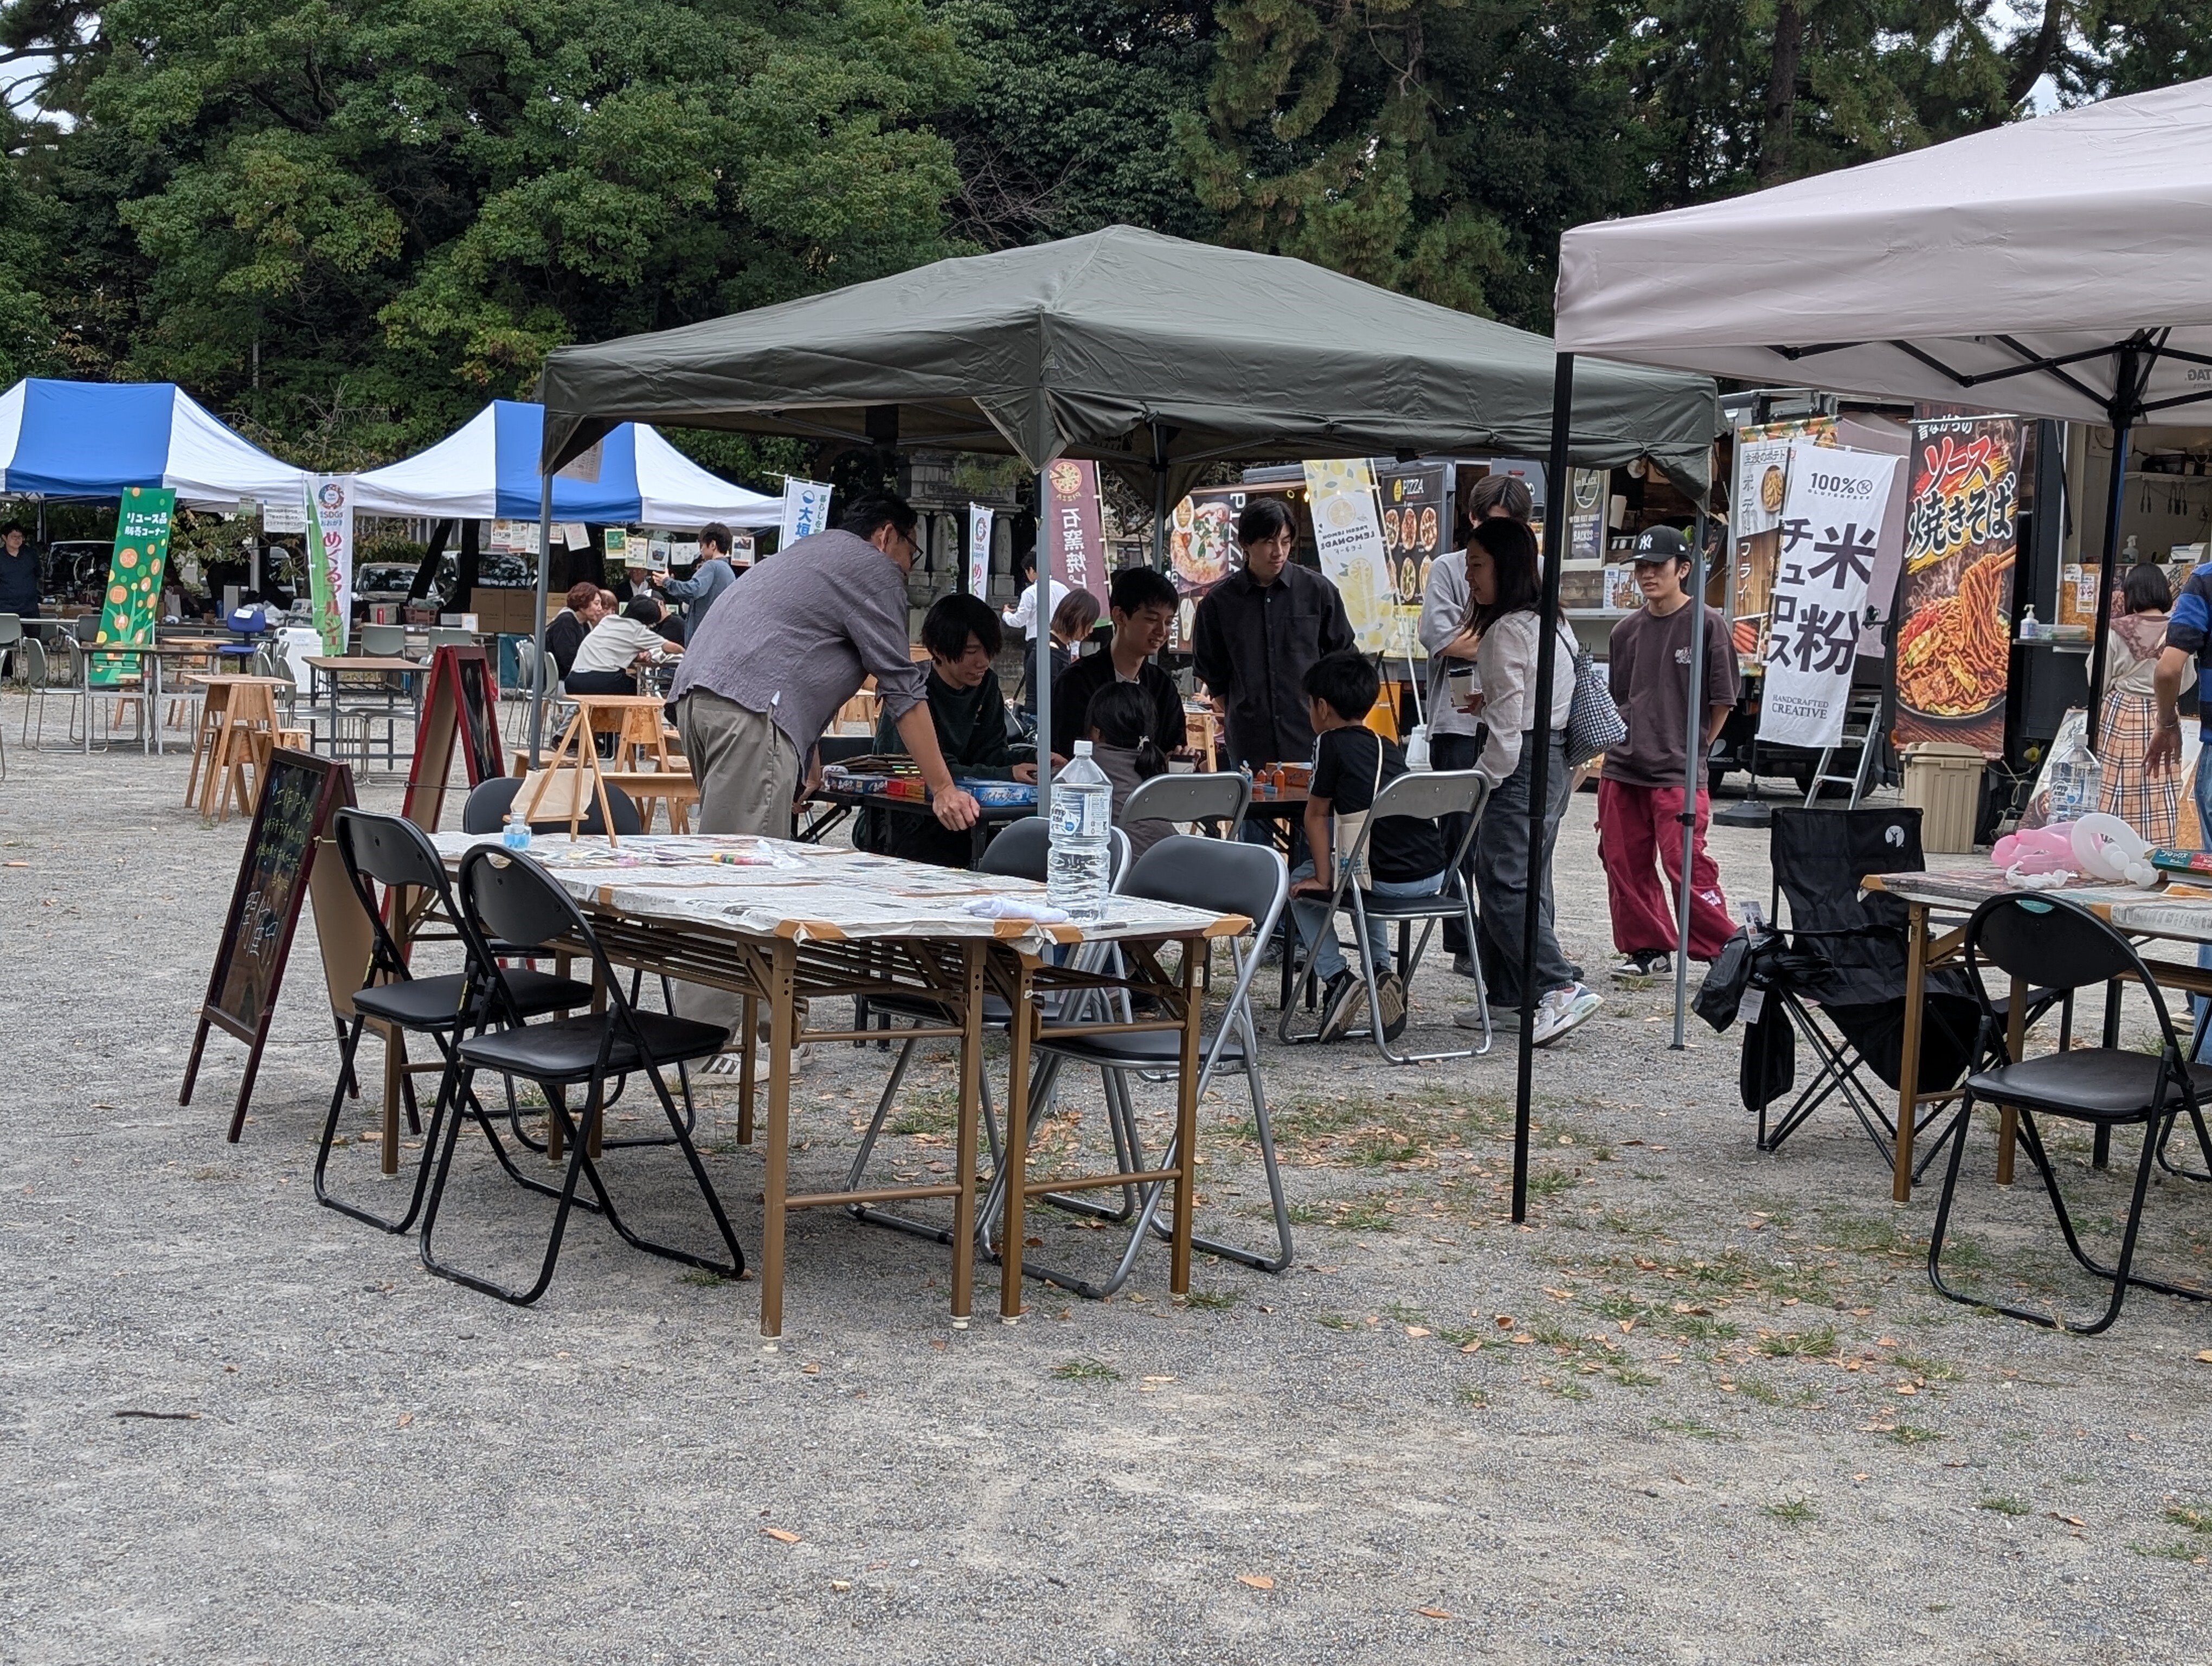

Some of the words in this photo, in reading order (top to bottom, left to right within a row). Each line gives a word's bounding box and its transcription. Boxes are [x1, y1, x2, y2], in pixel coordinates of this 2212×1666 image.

[1922, 435, 1992, 498] ソース
[1402, 478, 1424, 496] PIZZA
[1811, 472, 1857, 494] 100%
[127, 512, 168, 524] リユース品
[795, 507, 813, 537] 大垣
[1904, 471, 2017, 559] 焼きそば
[1767, 517, 1814, 668] チュロス
[1793, 523, 1877, 675] 米粉
[1771, 702, 1828, 720] CREATIVE
[1772, 694, 1829, 709] HANDCRAFTED
